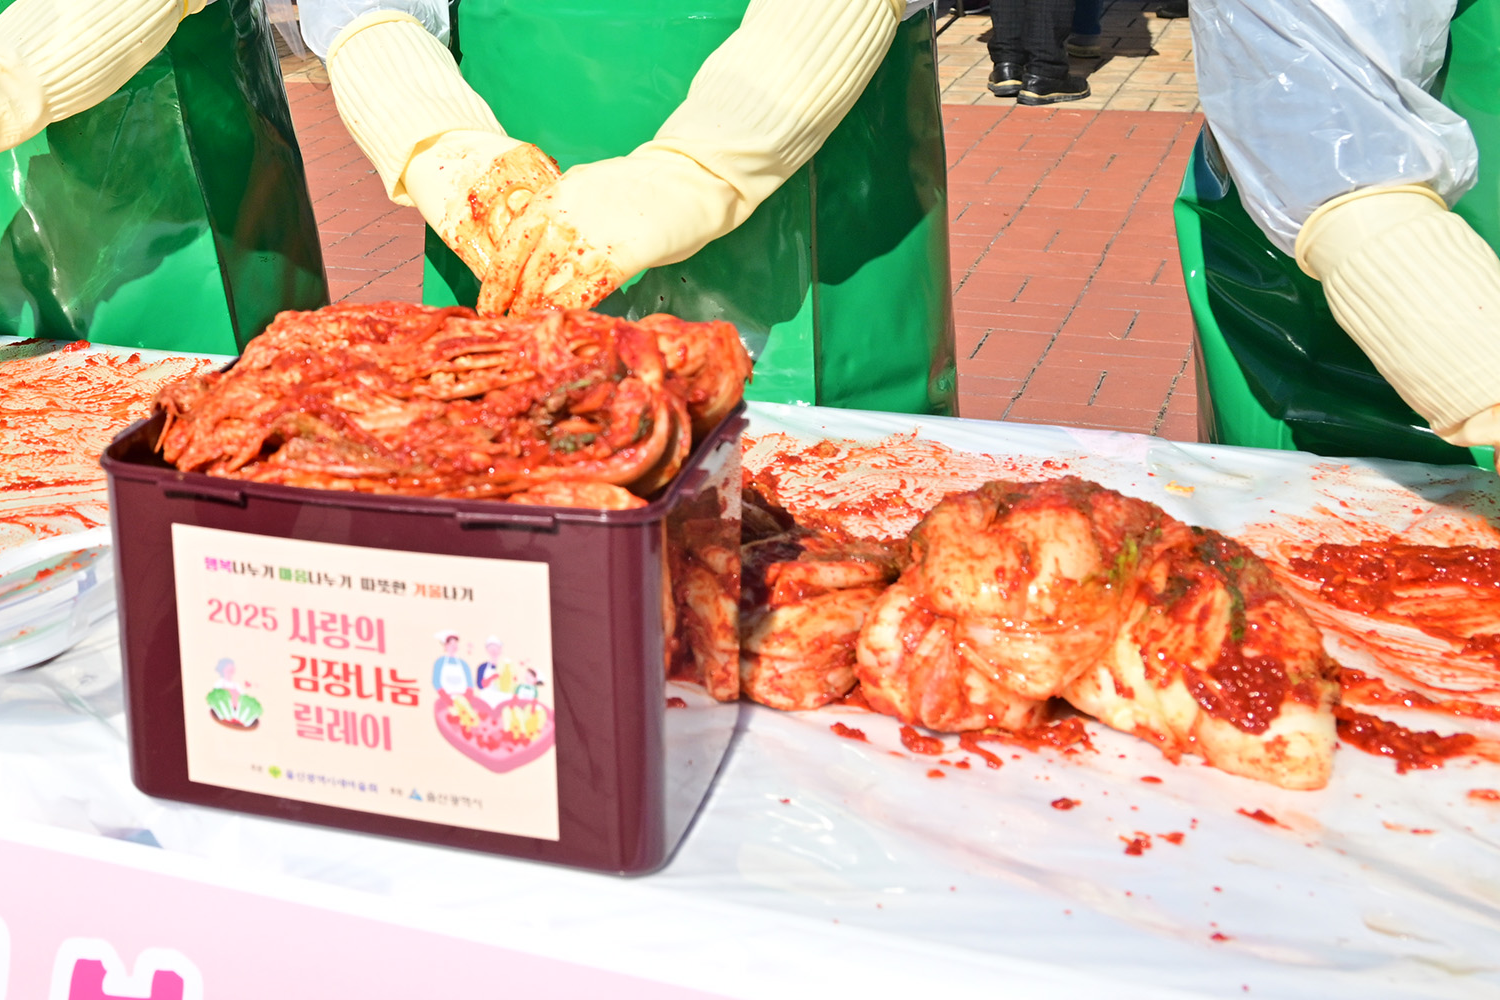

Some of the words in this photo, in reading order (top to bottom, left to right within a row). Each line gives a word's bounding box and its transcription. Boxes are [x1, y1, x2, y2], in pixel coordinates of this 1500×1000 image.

[207, 597, 278, 632] 2025
[289, 606, 386, 654] 사랑의
[290, 654, 420, 707] 김장나눔
[293, 702, 392, 751] 릴레이
